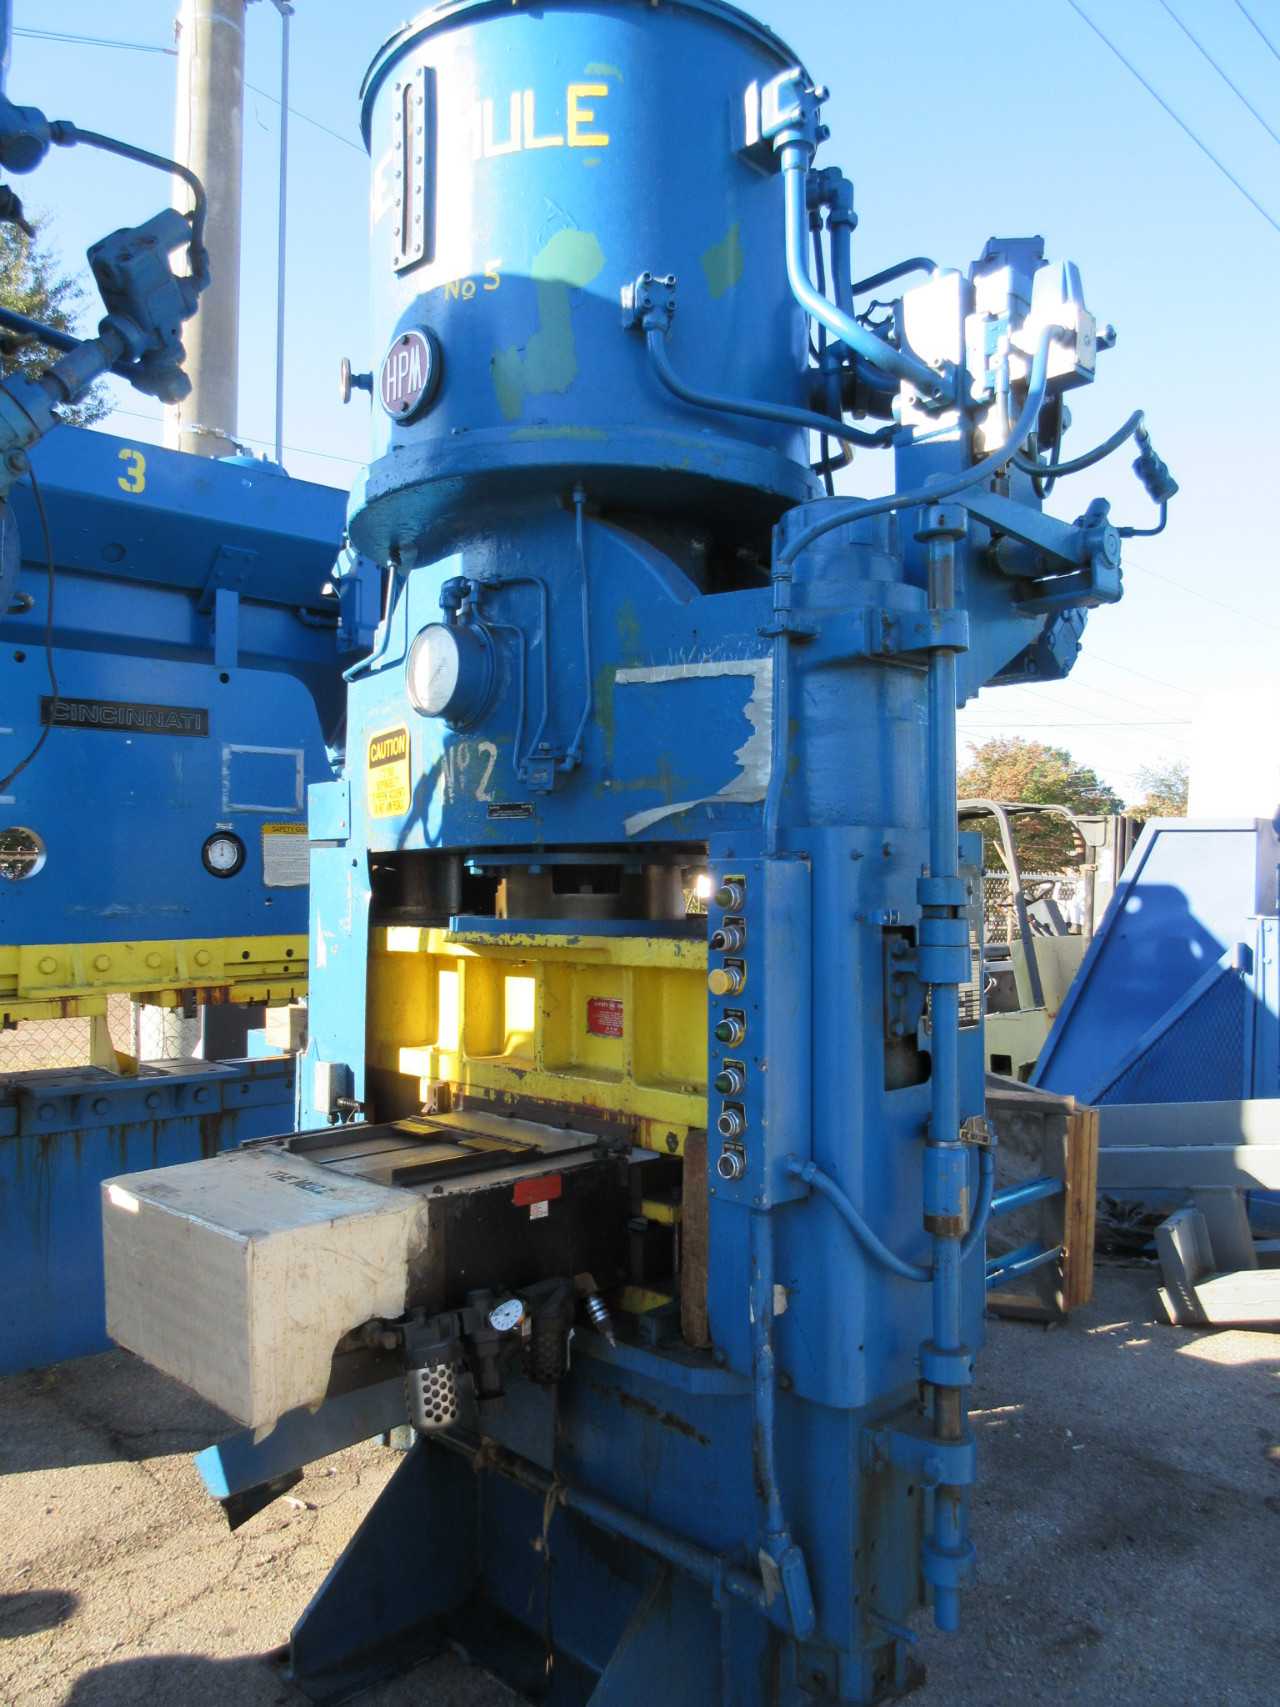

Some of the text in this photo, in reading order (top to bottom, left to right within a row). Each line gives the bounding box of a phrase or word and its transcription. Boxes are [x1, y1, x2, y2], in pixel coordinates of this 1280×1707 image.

[472, 84, 609, 158] ULE
[483, 259, 501, 290] 5
[386, 343, 421, 403] HPM
[117, 448, 146, 494] 3
[51, 701, 201, 730] CINCINNATI
[370, 735, 406, 762] CAUTION
[475, 741, 497, 801] 2
